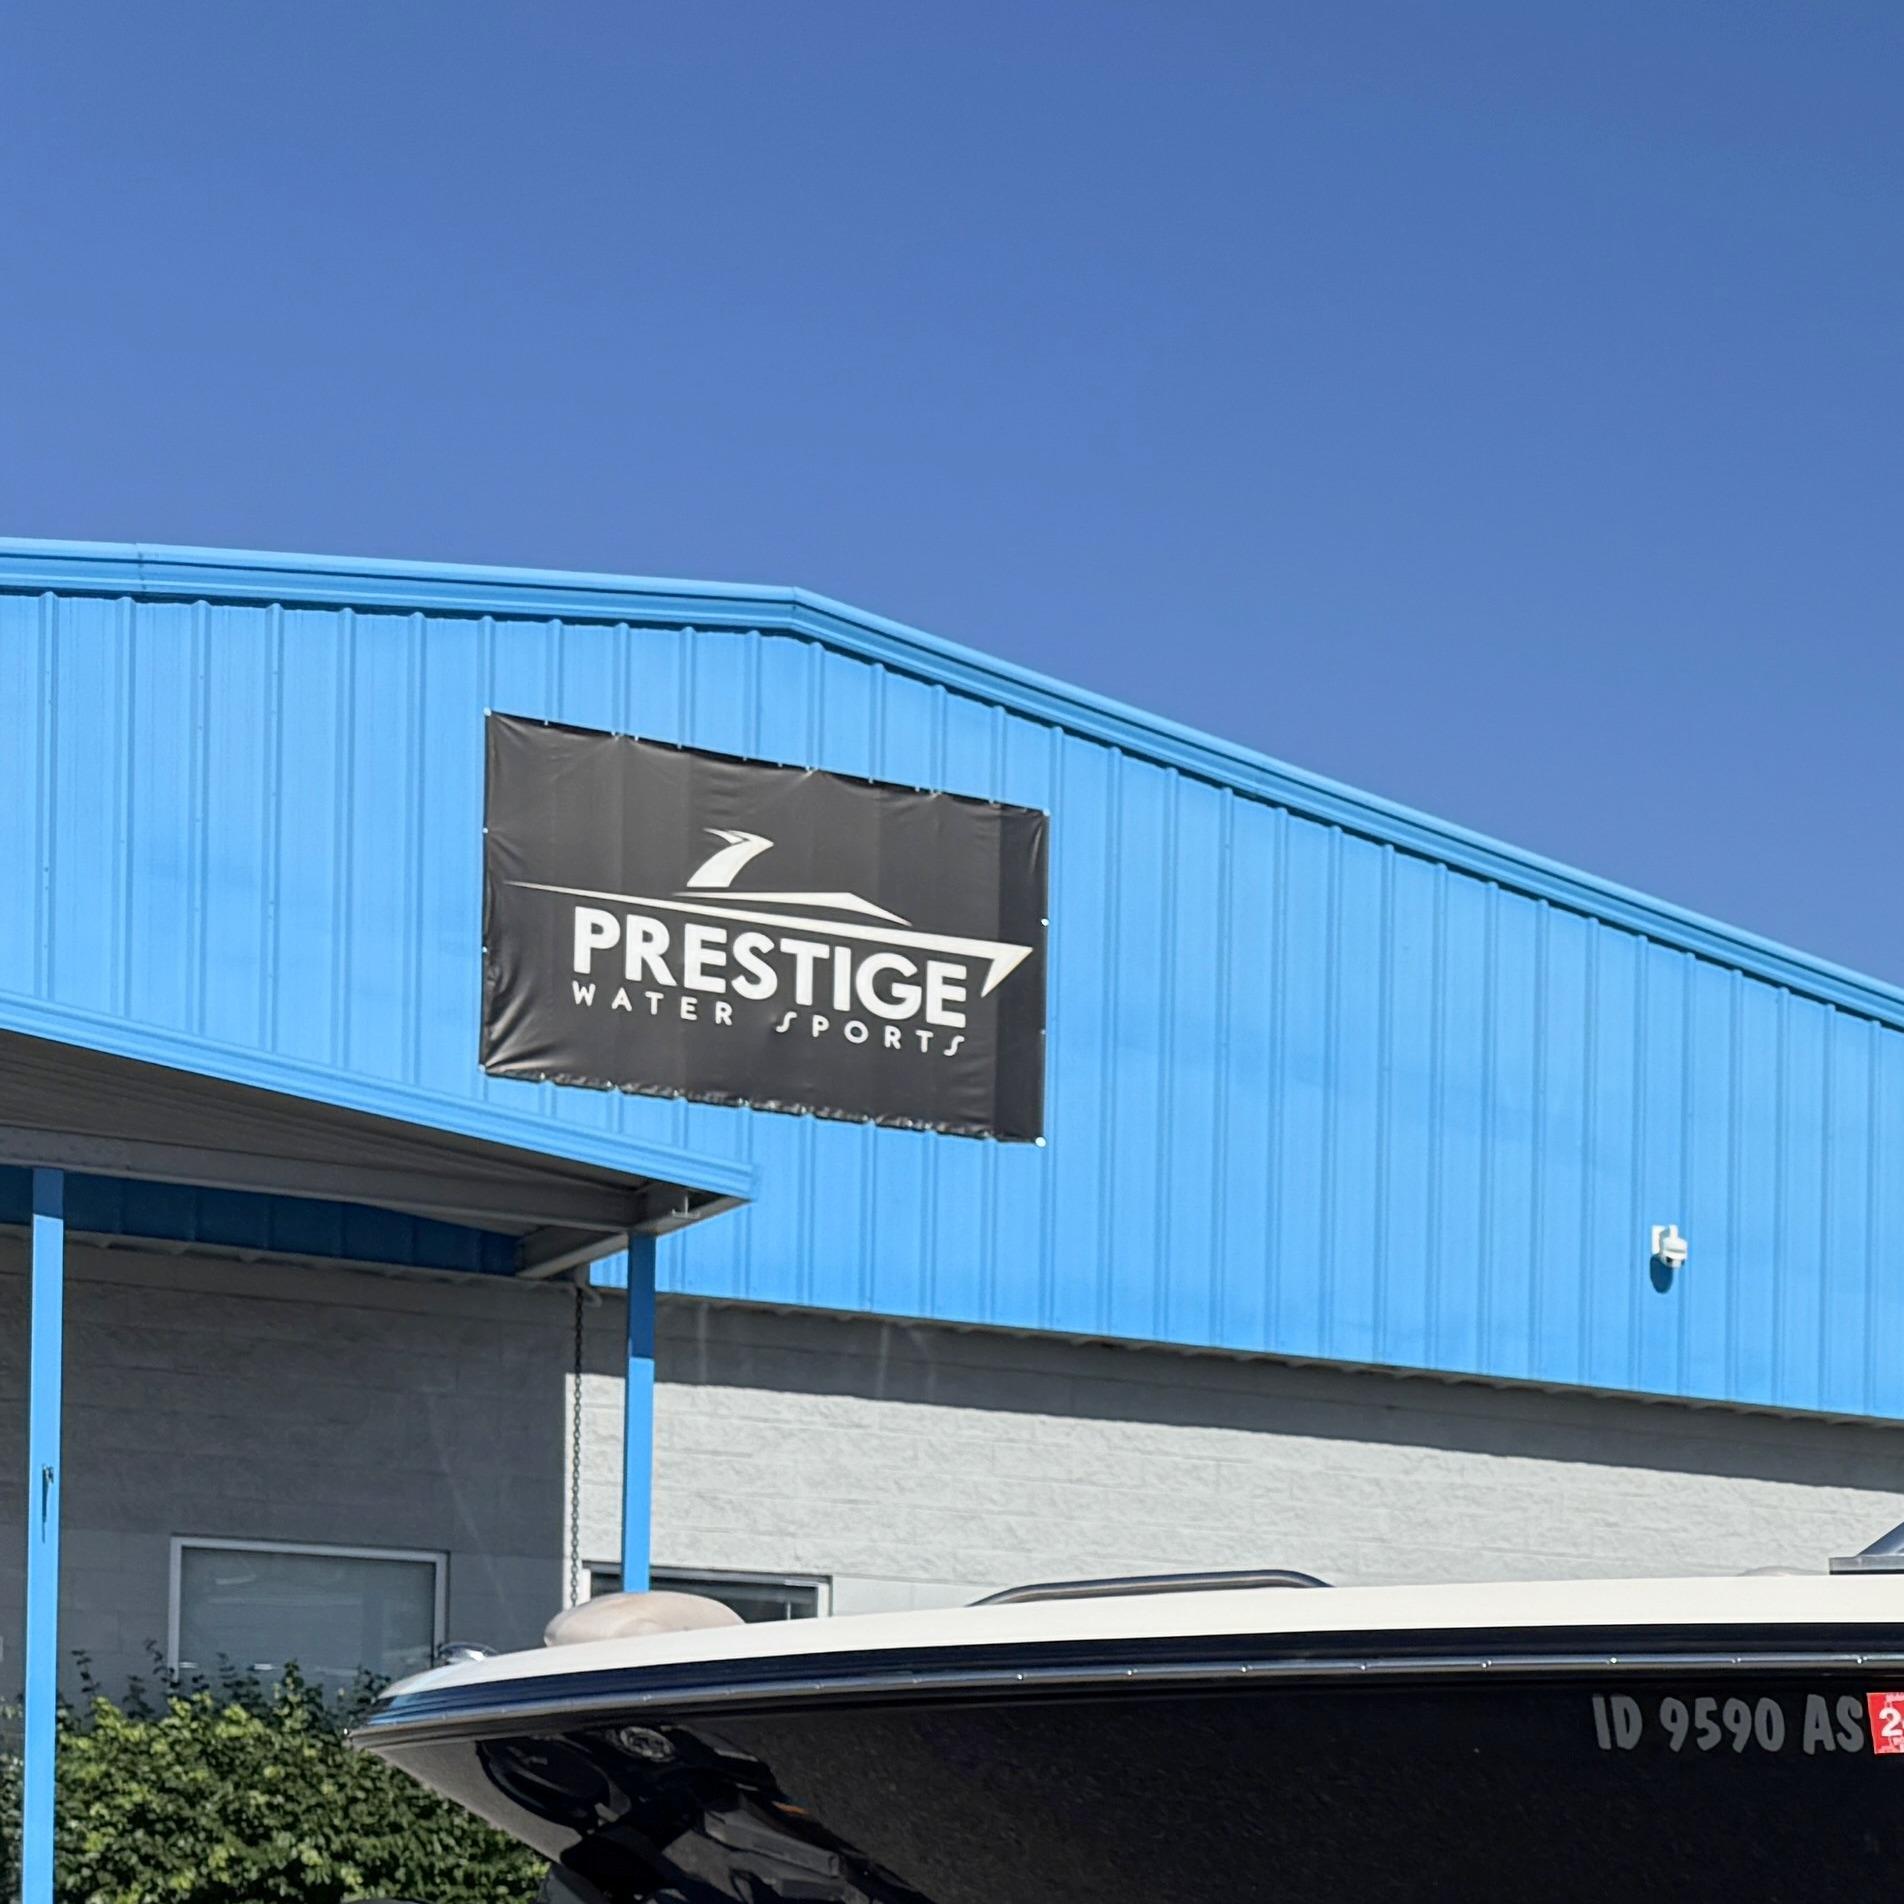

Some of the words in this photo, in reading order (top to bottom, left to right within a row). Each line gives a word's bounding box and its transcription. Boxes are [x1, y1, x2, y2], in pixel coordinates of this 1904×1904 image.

[574, 906, 967, 1029] PRESTIGE
[572, 981, 733, 1027] WATER
[775, 1011, 965, 1057] SPORTS
[1592, 1693, 1643, 1751] ID
[1659, 1697, 1785, 1753] 9590
[1802, 1694, 1864, 1755] AS
